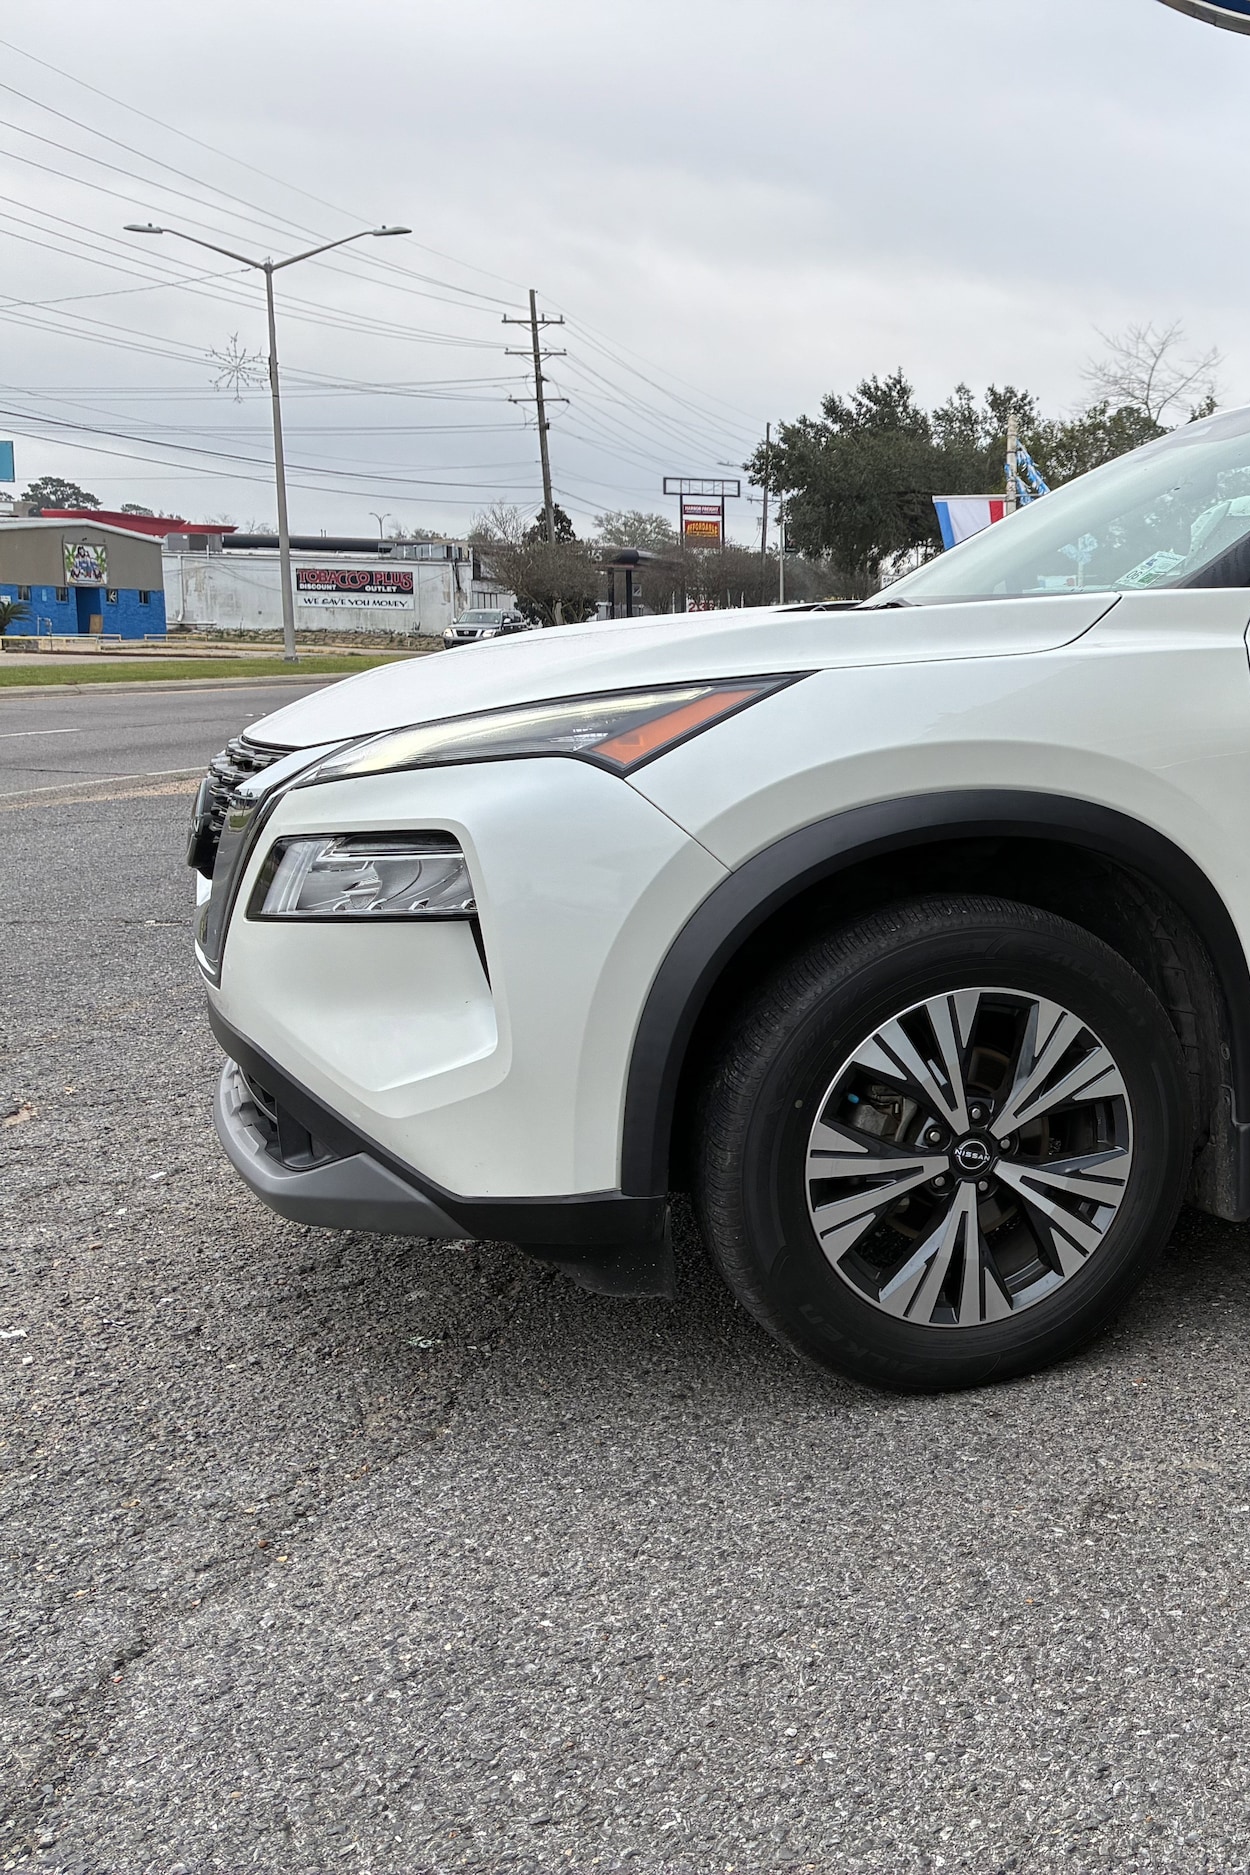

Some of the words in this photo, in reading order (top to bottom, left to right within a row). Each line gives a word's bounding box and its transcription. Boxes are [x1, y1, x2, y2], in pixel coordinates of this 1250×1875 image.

[297, 569, 370, 588] TOBACCO
[373, 571, 412, 591] PLUS
[348, 598, 370, 606] YOU
[372, 599, 408, 607] MONEY
[954, 1148, 991, 1161] NISSAN
